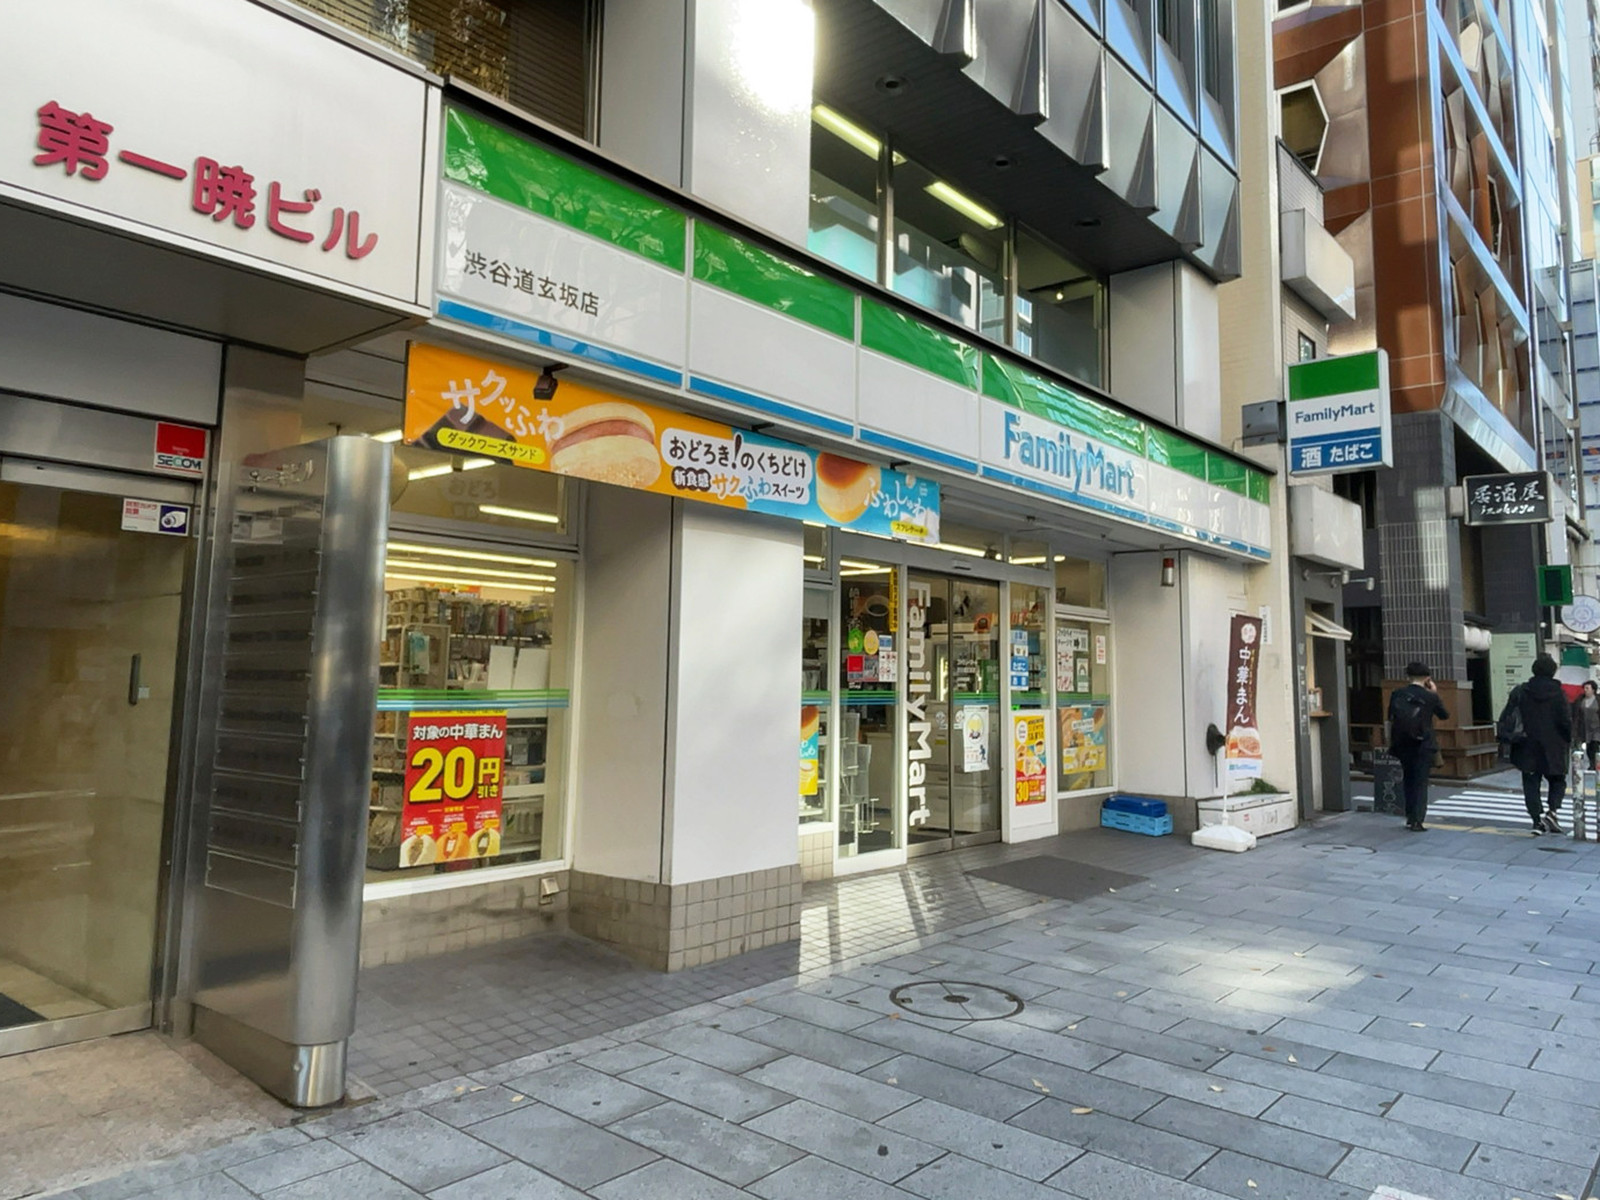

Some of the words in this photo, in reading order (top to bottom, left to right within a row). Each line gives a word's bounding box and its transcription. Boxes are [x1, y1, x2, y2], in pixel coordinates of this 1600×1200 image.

[34, 100, 378, 259] 第一暁ビル
[464, 249, 600, 317] 渋谷道玄坂店
[1295, 402, 1375, 424] FamilyMart
[446, 431, 538, 461] ダックワーズサンド
[1004, 410, 1135, 499] FamilyMart
[1301, 446, 1322, 469] 酒
[1329, 442, 1374, 463] たばこ
[157, 454, 201, 470] SECOM
[1469, 480, 1545, 505] 居酒屋
[1233, 646, 1252, 725] 中華まん
[906, 581, 932, 827] FamilyMart
[412, 723, 504, 742] 対象の中華まん
